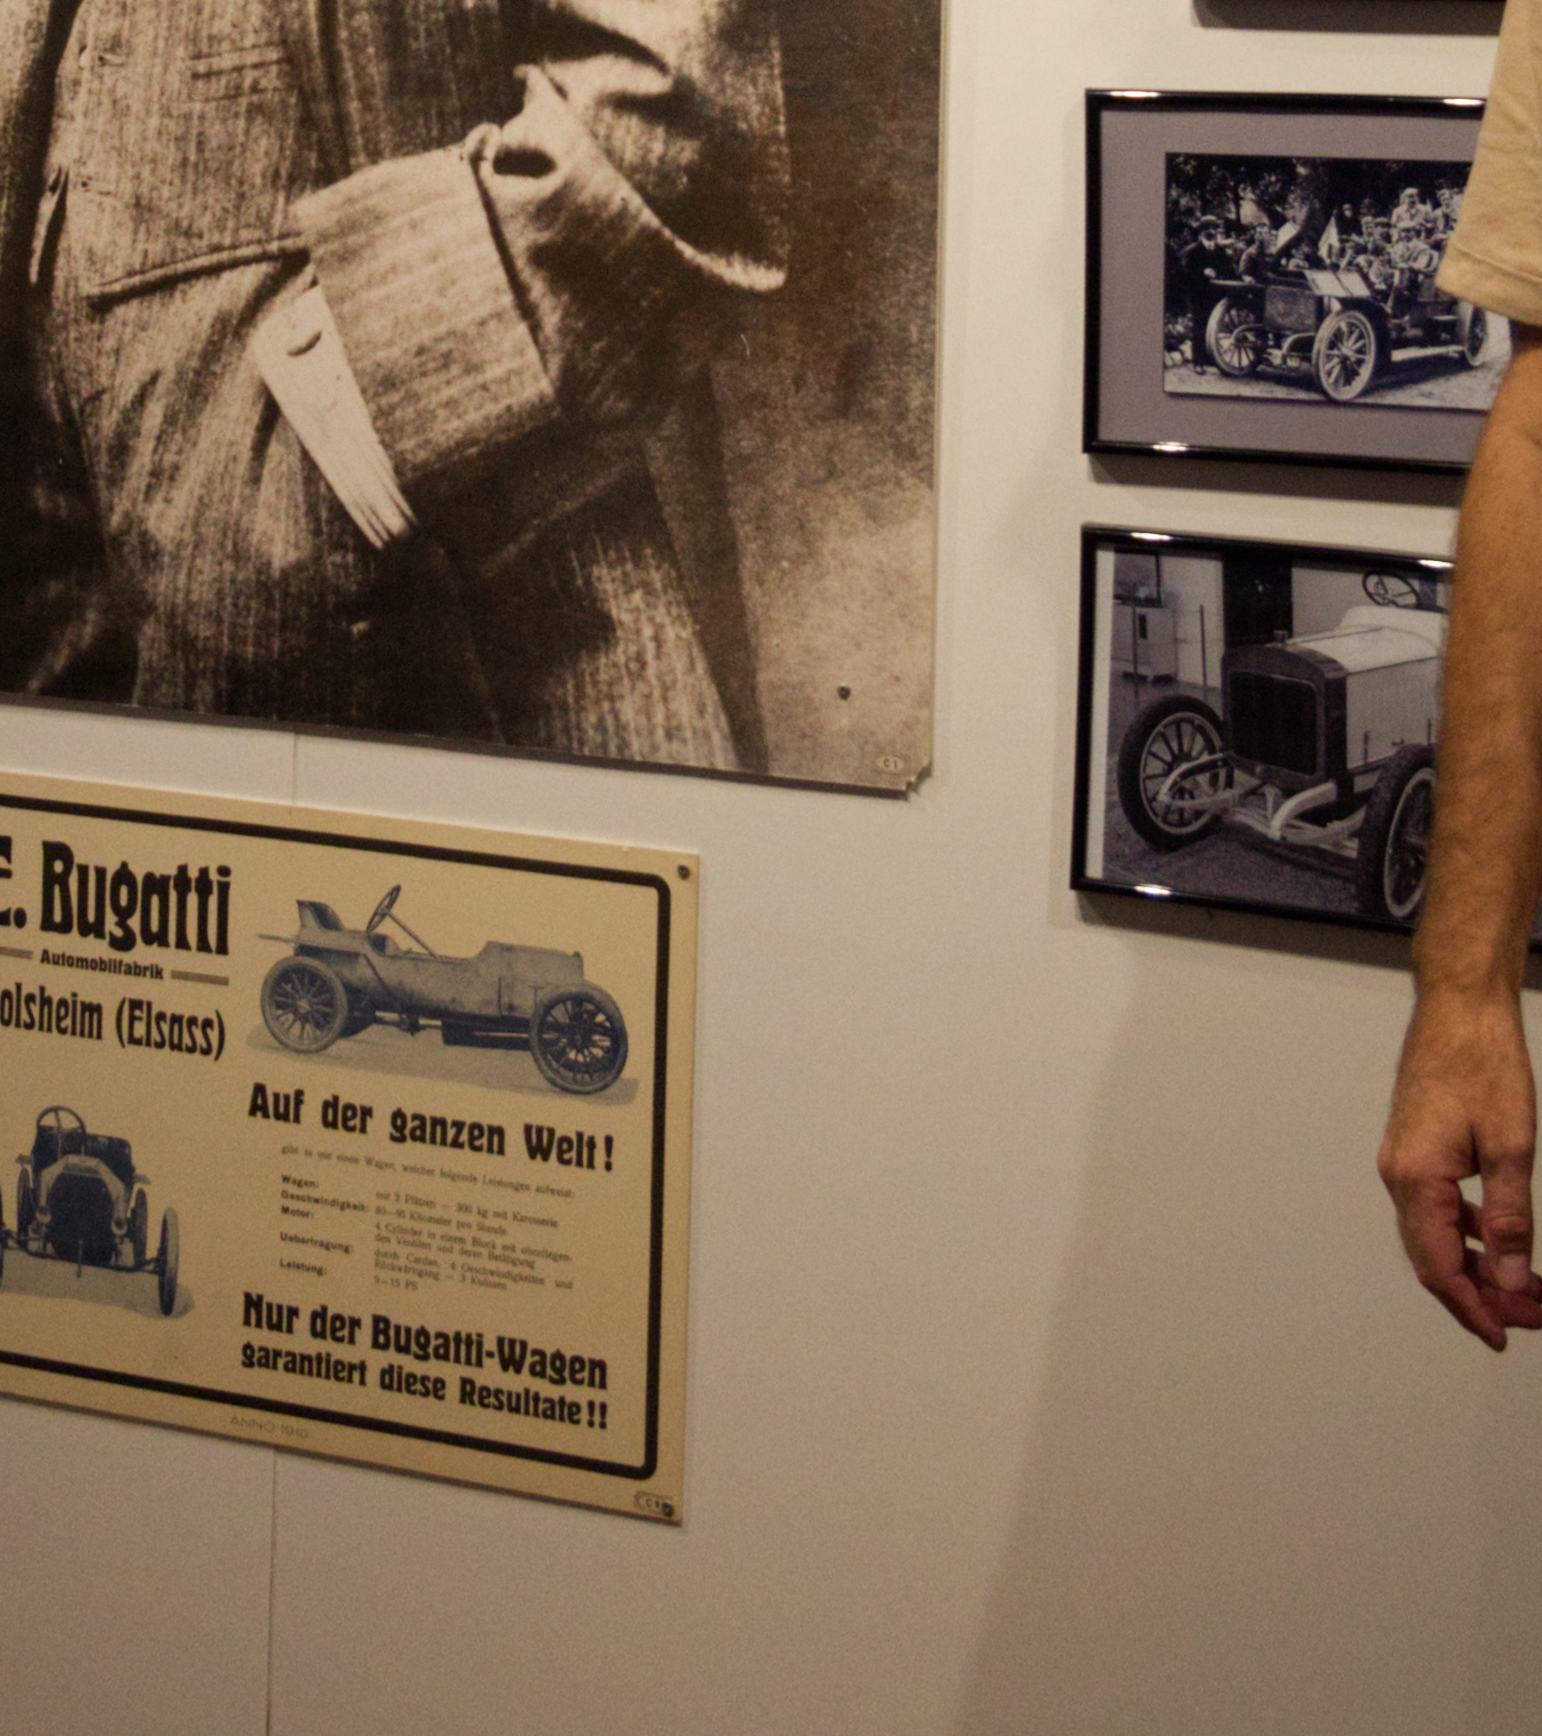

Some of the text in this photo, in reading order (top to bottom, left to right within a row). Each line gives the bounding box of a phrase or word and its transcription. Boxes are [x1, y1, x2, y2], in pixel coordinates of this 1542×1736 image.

[39, 839, 232, 957] Bugatti
[39, 948, 165, 981] Automobilfabrik
[115, 996, 226, 1062] (Elsass)
[247, 1081, 305, 1126] Auf
[320, 1093, 374, 1135] der
[388, 1106, 506, 1156] ganzen
[280, 1173, 320, 1189] Wagen:
[280, 1188, 370, 1214] Geschwindigkeit:
[280, 1204, 316, 1220] Motor:
[279, 1230, 355, 1256] Uebertragung:
[278, 1257, 328, 1278] Leistung:
[242, 1290, 609, 1391] Nur der Bugatti-Wagen
[241, 1340, 609, 1431] garantiert diese Resultate!!
